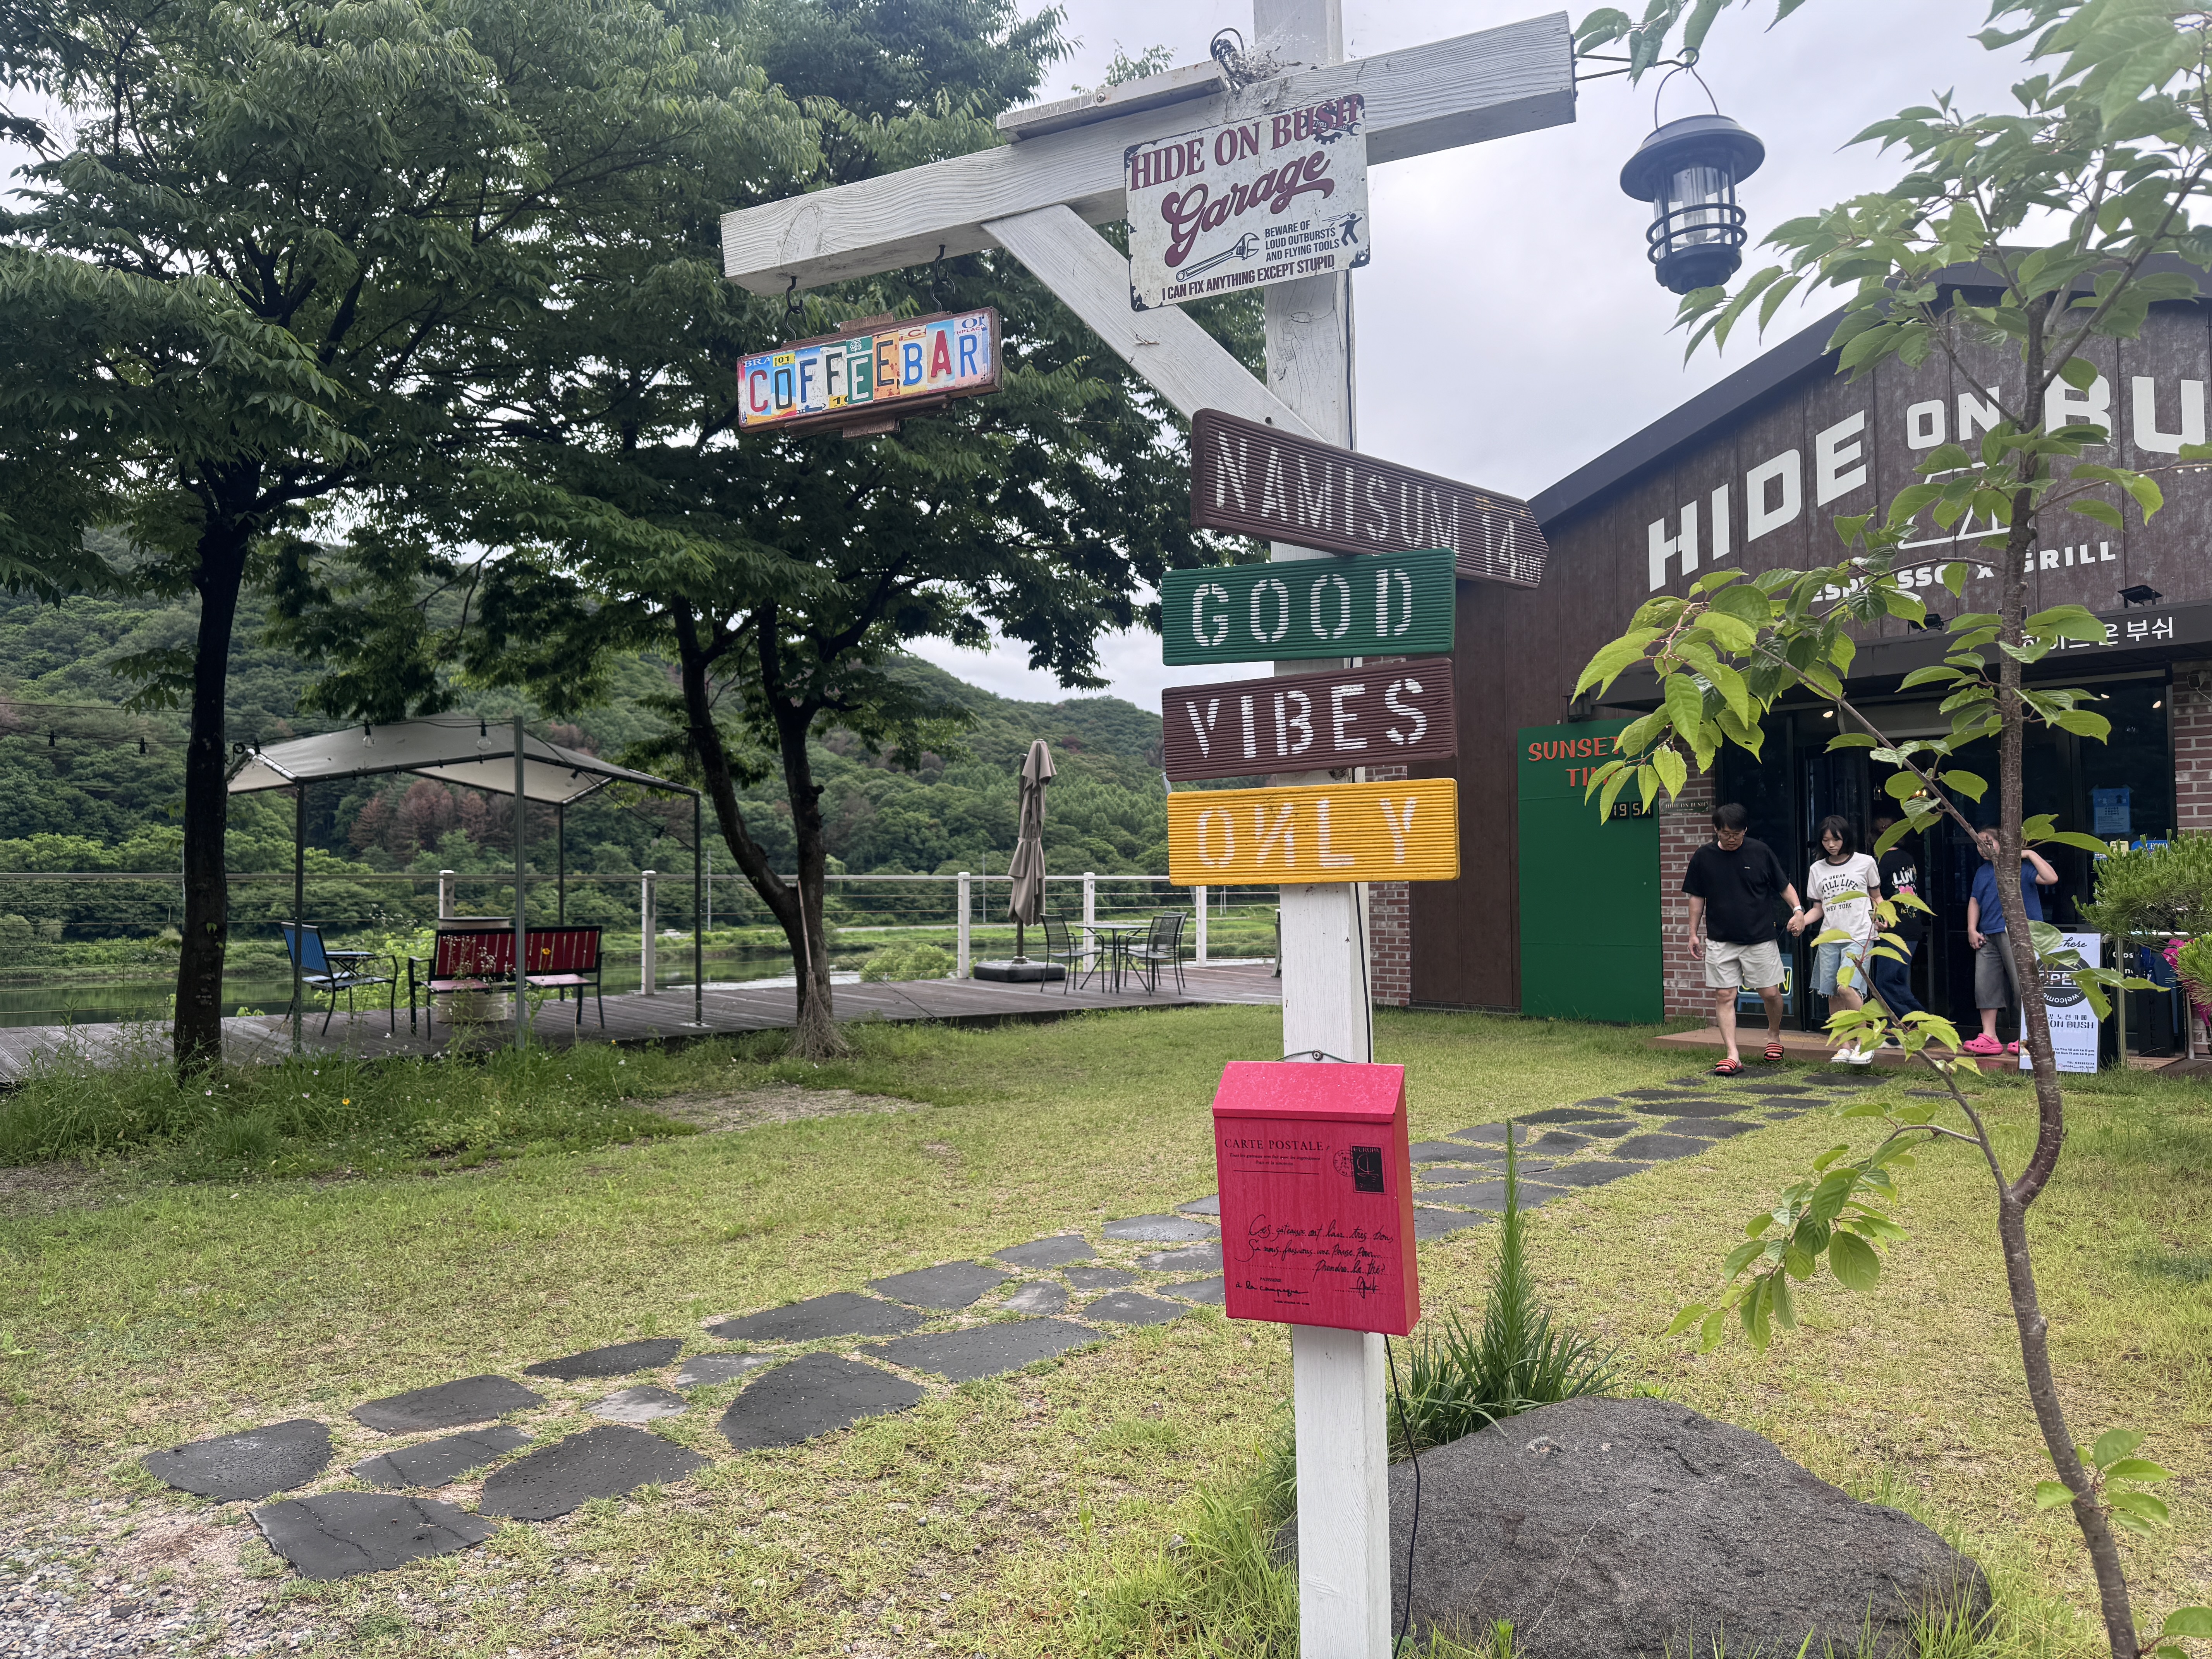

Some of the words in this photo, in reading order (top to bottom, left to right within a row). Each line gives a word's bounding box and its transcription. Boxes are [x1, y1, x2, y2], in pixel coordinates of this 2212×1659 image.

[1130, 137, 1205, 191] HIDE
[1214, 121, 1261, 166] ON
[1271, 95, 1360, 150] BUSH
[1161, 150, 1335, 268] Garage
[1265, 222, 1298, 238] BEWARE
[1300, 220, 1310, 230] OF
[1266, 237, 1286, 250] LOUD
[1288, 227, 1336, 245] OUTBURSTS
[1266, 250, 1282, 262] AND
[1285, 244, 1311, 258] FLYING
[1313, 239, 1340, 252] TOOLS
[1162, 288, 1166, 301] I
[1168, 283, 1187, 300] CAN
[1189, 280, 1204, 295] FIX
[1206, 270, 1255, 292] ANYTHING
[1257, 261, 1295, 282] EXCEPT
[1297, 254, 1335, 273] STUPID
[1216, 432, 1460, 557] NAMISUM
[1648, 409, 1867, 592] HIDE
[1907, 386, 2000, 450] ON
[2044, 369, 2206, 454] BU
[1192, 568, 1412, 647] GOOD
[2126, 617, 2173, 642] 부쉬
[1186, 678, 1427, 759] VIBES
[1841, 879, 1858, 890] LIFE
[1224, 1139, 1264, 1149] CARTE
[1269, 1140, 1324, 1151] POSTALE
